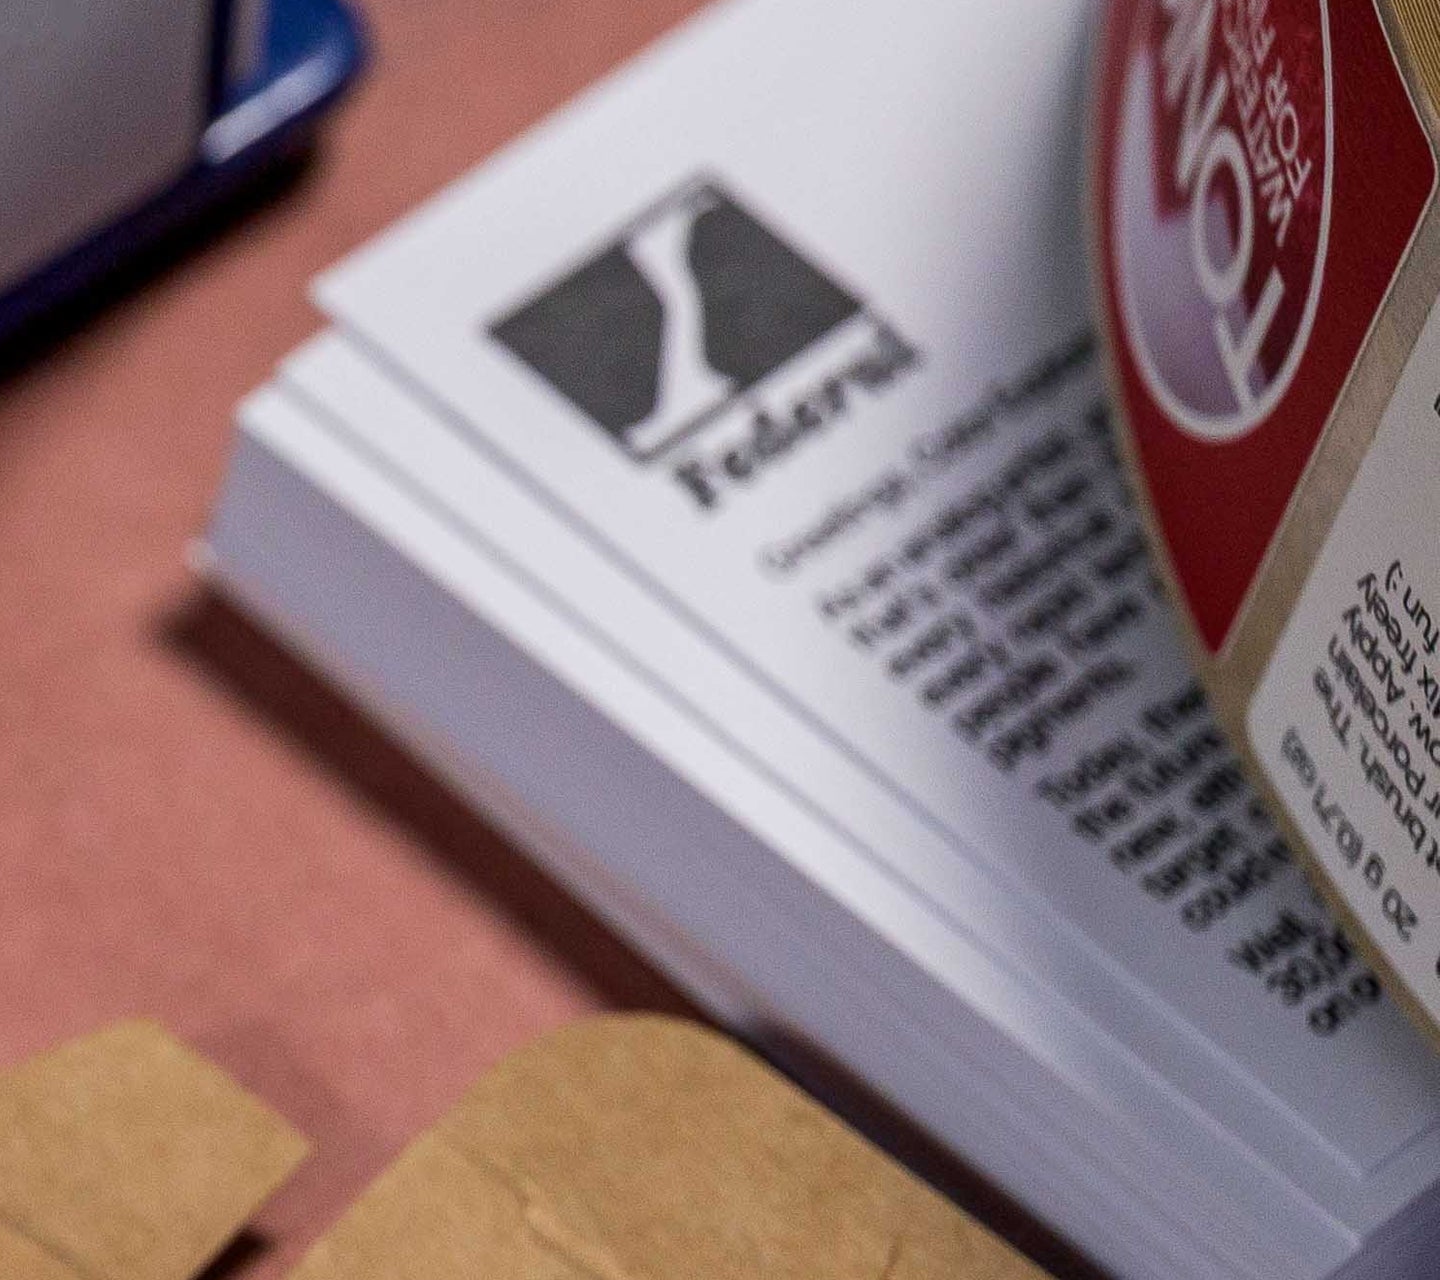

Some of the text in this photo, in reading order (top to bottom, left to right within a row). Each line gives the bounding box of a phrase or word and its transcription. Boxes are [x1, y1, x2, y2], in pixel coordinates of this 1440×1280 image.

[675, 315, 925, 510] Federal
[1313, 666, 1352, 751] The
[1342, 605, 1405, 704] Apply
[1359, 733, 1427, 855] brush.
